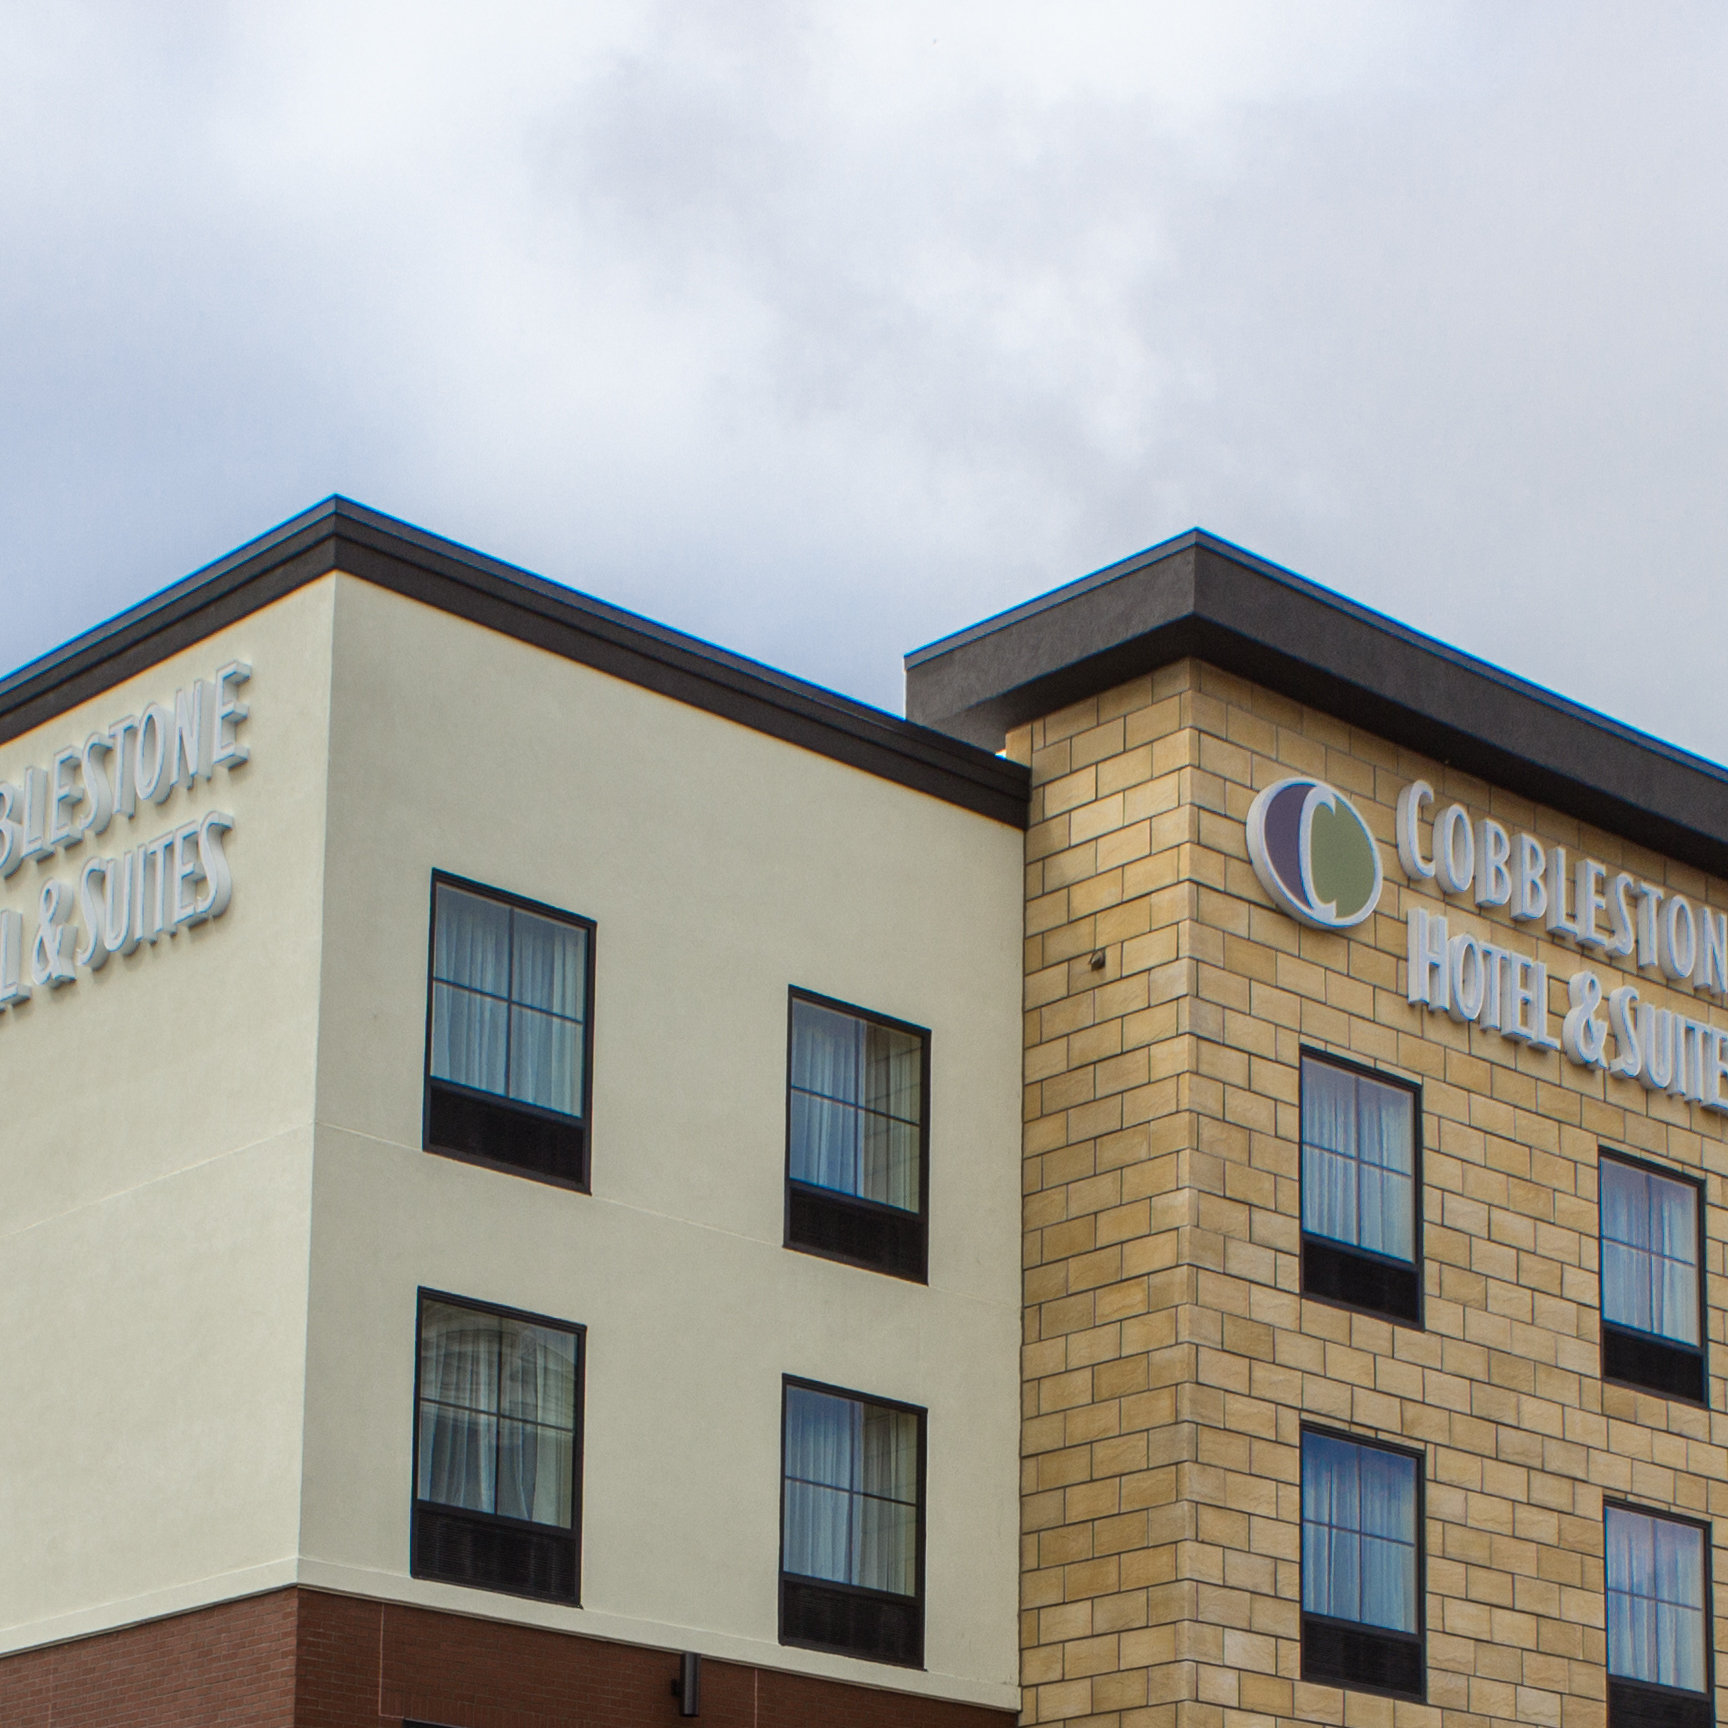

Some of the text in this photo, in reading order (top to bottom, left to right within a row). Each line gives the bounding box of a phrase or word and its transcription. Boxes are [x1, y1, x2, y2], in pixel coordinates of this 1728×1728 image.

[32, 878, 76, 988] &
[75, 810, 235, 971] SUITES
[1407, 907, 1560, 1052] HOTEL
[1562, 970, 1609, 1070] &
